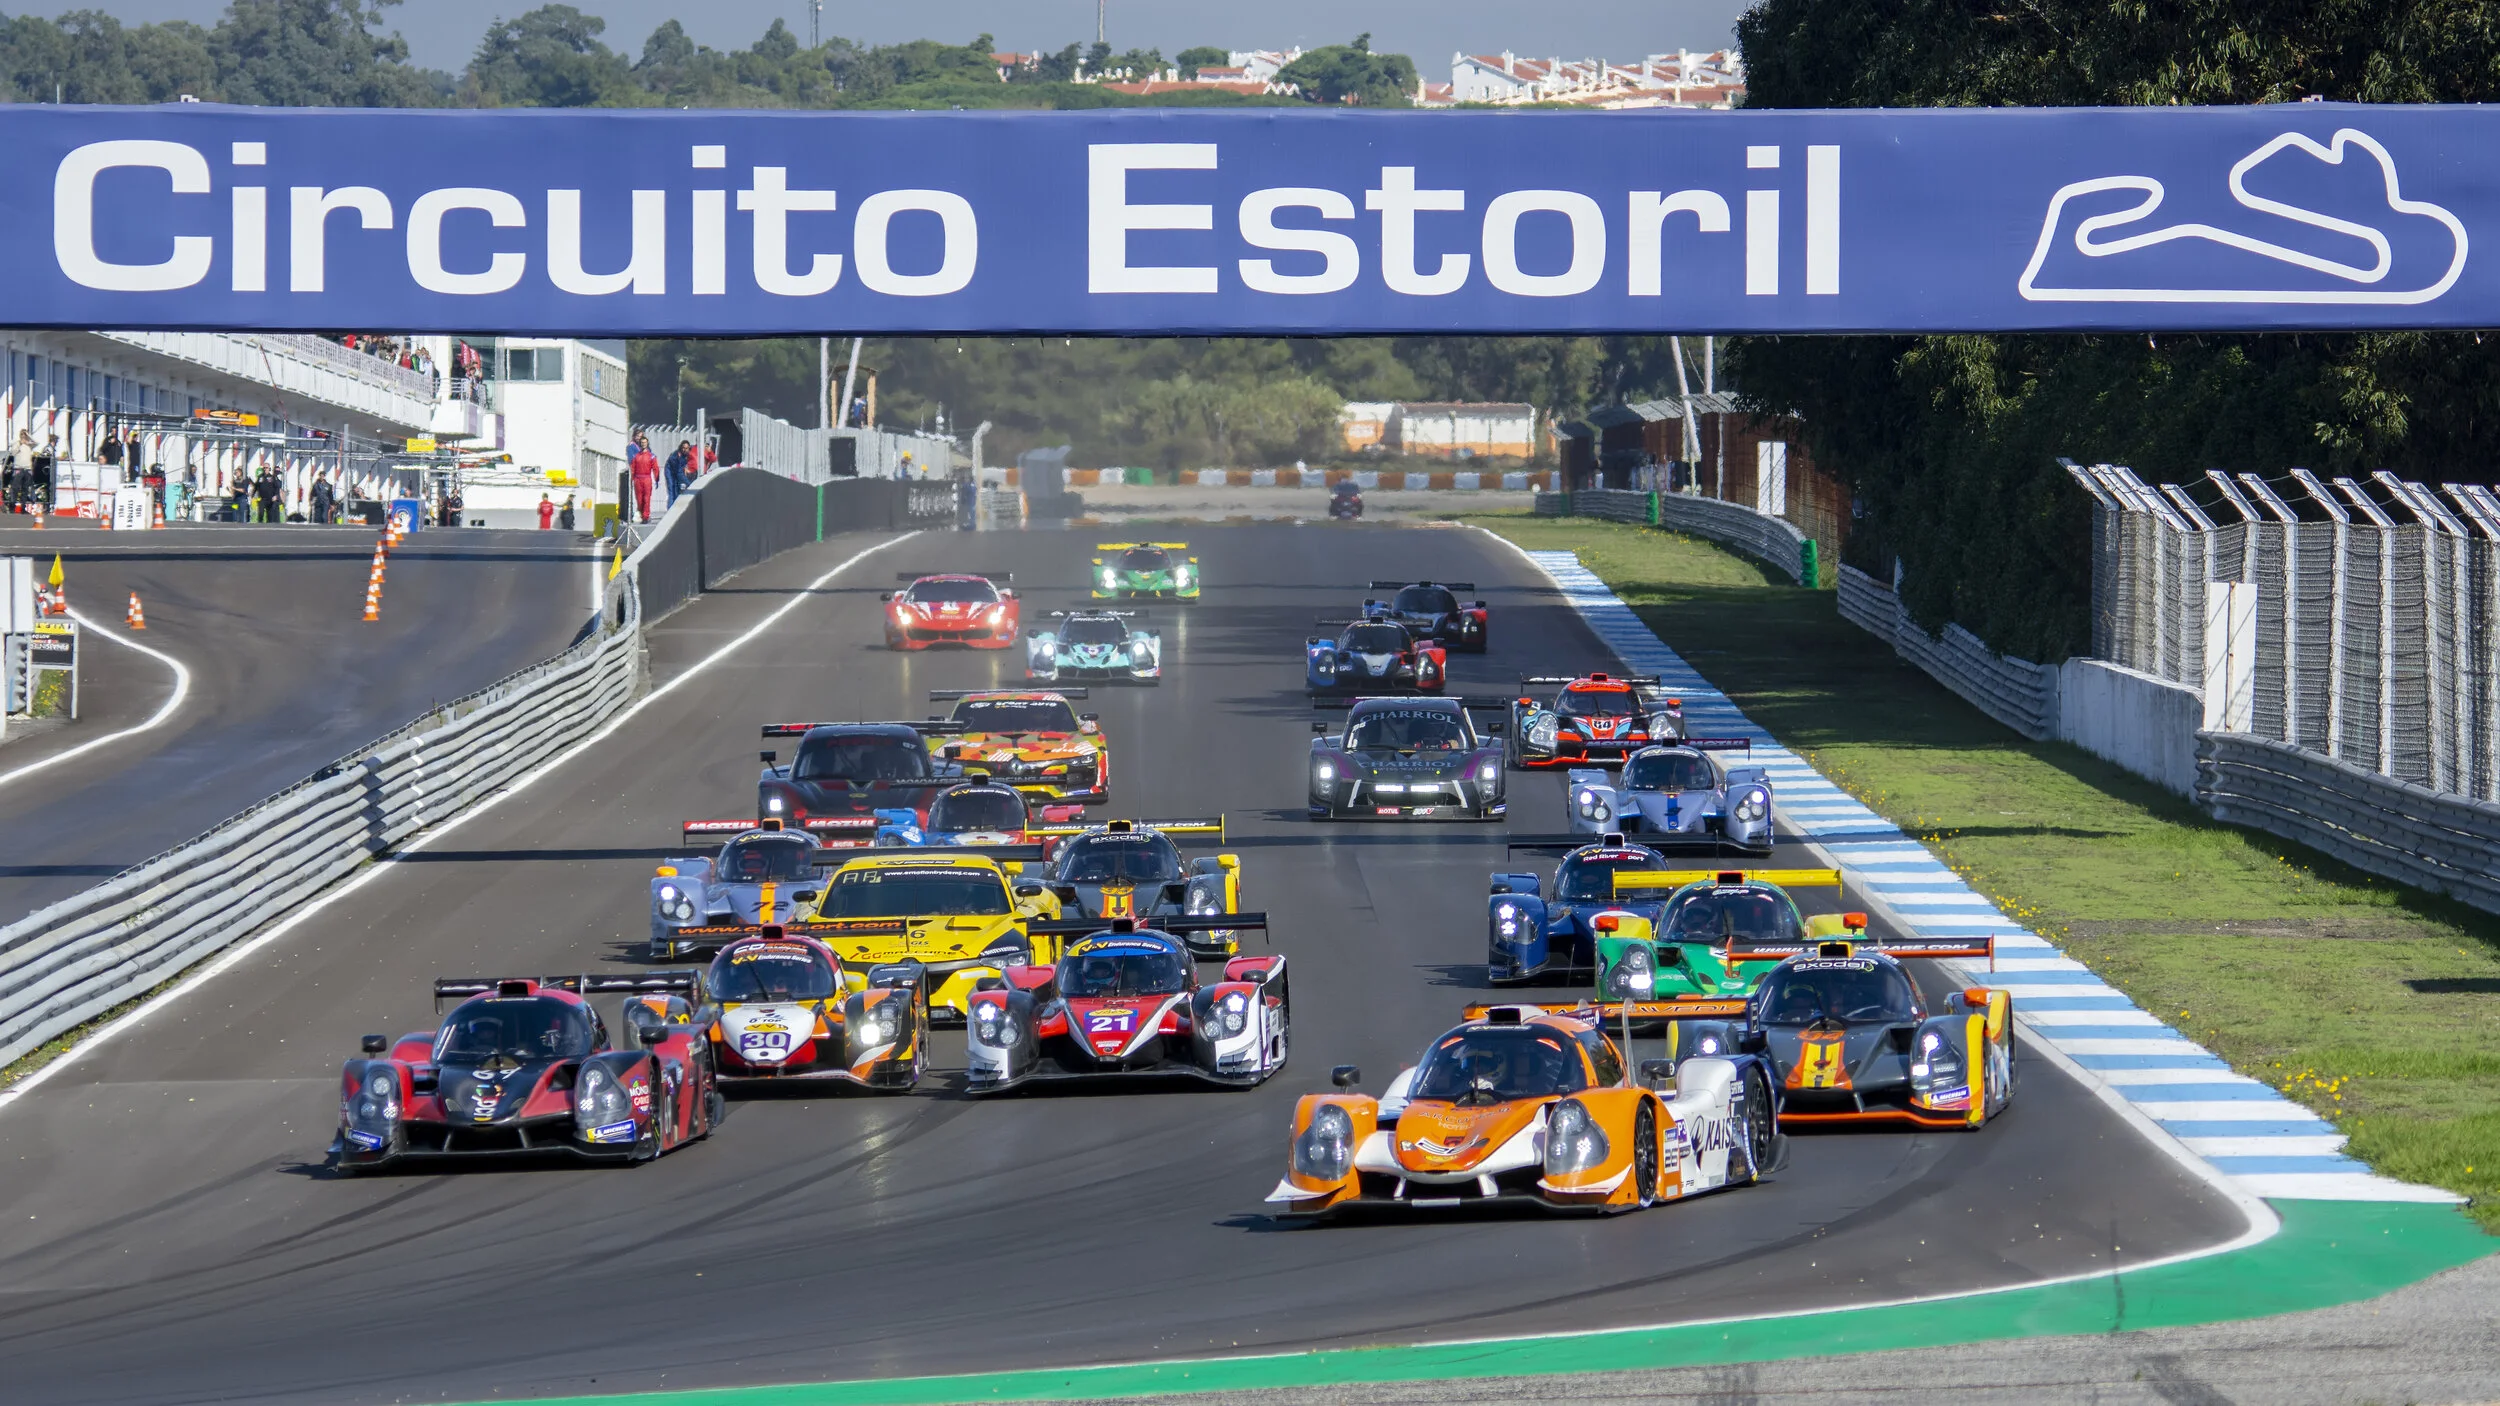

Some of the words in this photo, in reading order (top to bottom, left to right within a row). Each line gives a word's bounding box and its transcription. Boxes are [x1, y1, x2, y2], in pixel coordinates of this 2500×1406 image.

[53, 139, 978, 297] Circuito
[1088, 143, 1840, 297] Estoril
[1360, 710, 1456, 725] CHARRIOL
[1358, 760, 1456, 769] CHARRIOL
[687, 822, 755, 830] MOTUL
[808, 820, 875, 828] MOTUL
[751, 901, 789, 912] 72
[1792, 960, 1865, 972] axodel
[1091, 1016, 1129, 1032] 21
[744, 1032, 787, 1048] 30
